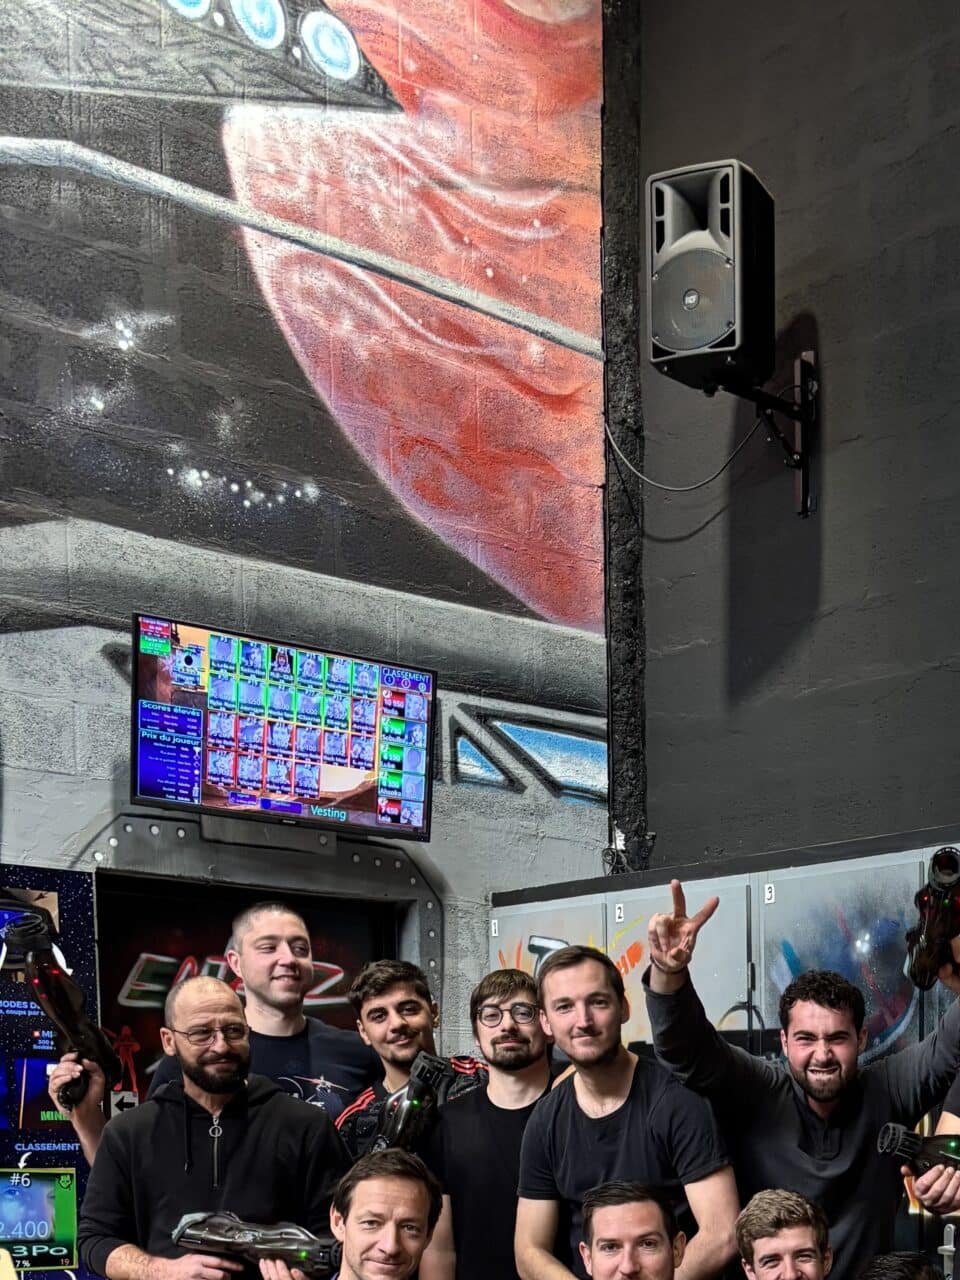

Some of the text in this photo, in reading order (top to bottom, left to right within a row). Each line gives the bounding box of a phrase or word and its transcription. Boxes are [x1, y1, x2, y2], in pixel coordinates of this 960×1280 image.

[382, 667, 430, 683] CLASSEMENT
[142, 702, 171, 712] Scores
[141, 730, 201, 746] Prix du joueur
[311, 805, 347, 821] Vesting
[767, 886, 773, 901] 3
[617, 906, 623, 919] 2
[14, 1143, 80, 1151] CLASSEMENT
[10, 1173, 31, 1187] #6
